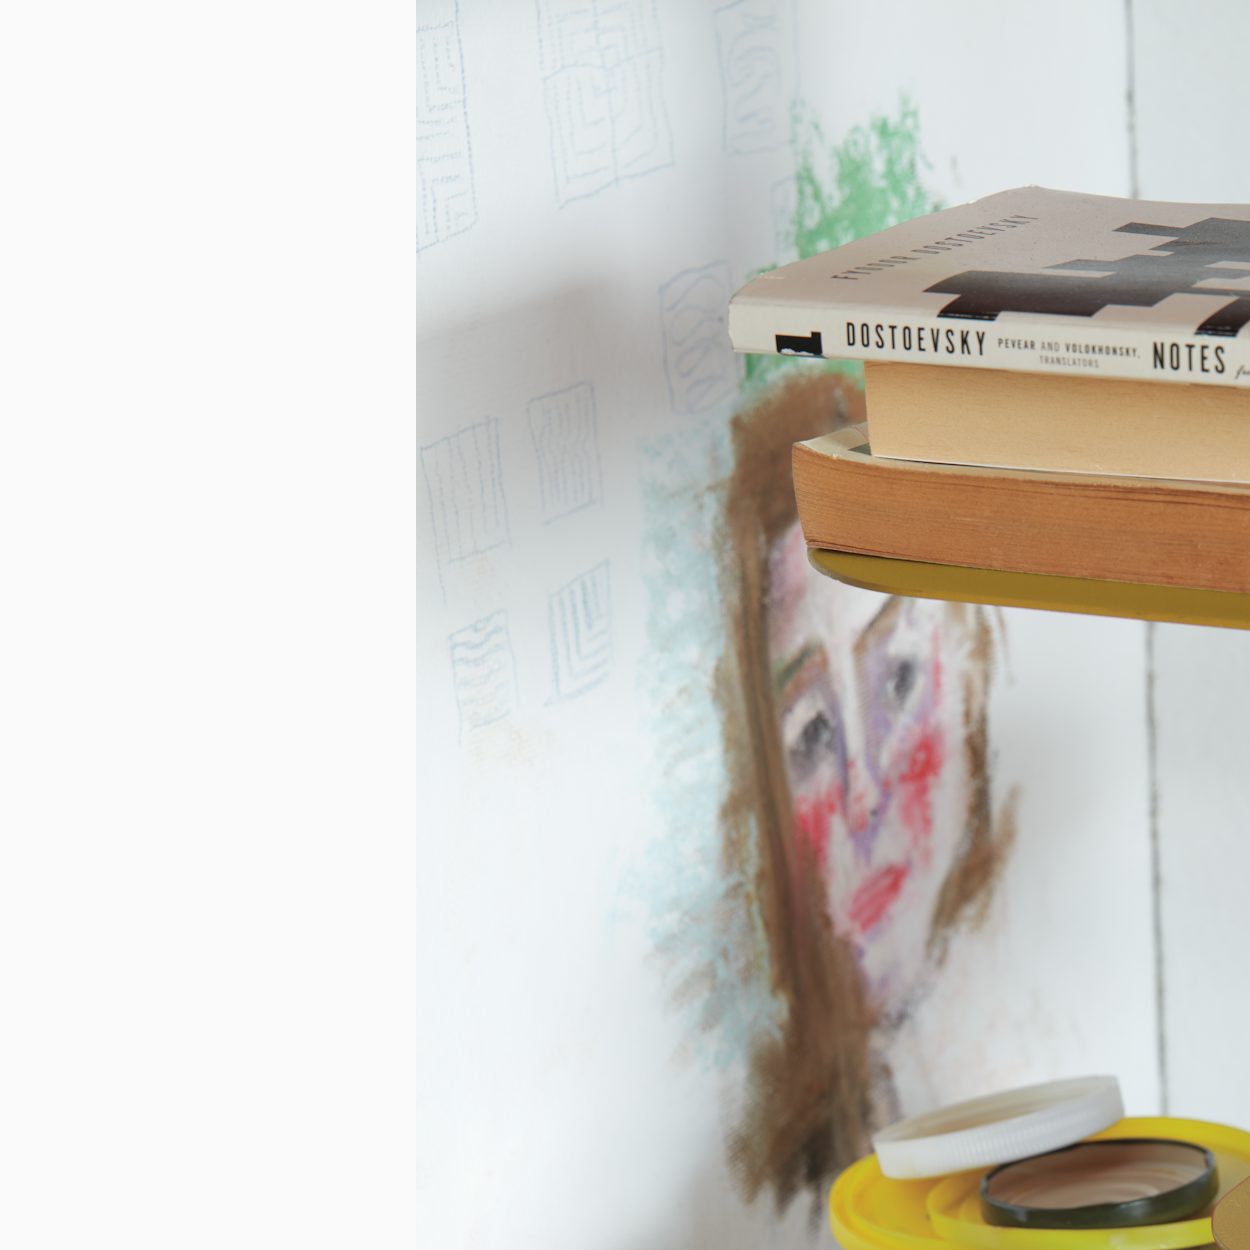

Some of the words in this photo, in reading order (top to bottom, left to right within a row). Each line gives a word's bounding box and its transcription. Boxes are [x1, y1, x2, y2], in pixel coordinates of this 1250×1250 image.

[911, 214, 1039, 255] DOSTOEVSKY
[845, 321, 986, 356] DOSTOEVSKY
[997, 337, 1036, 350] PEVEAR
[1039, 340, 1061, 353] AND
[1039, 355, 1100, 369] TRANSLATORS
[1152, 341, 1226, 374] NOTES
